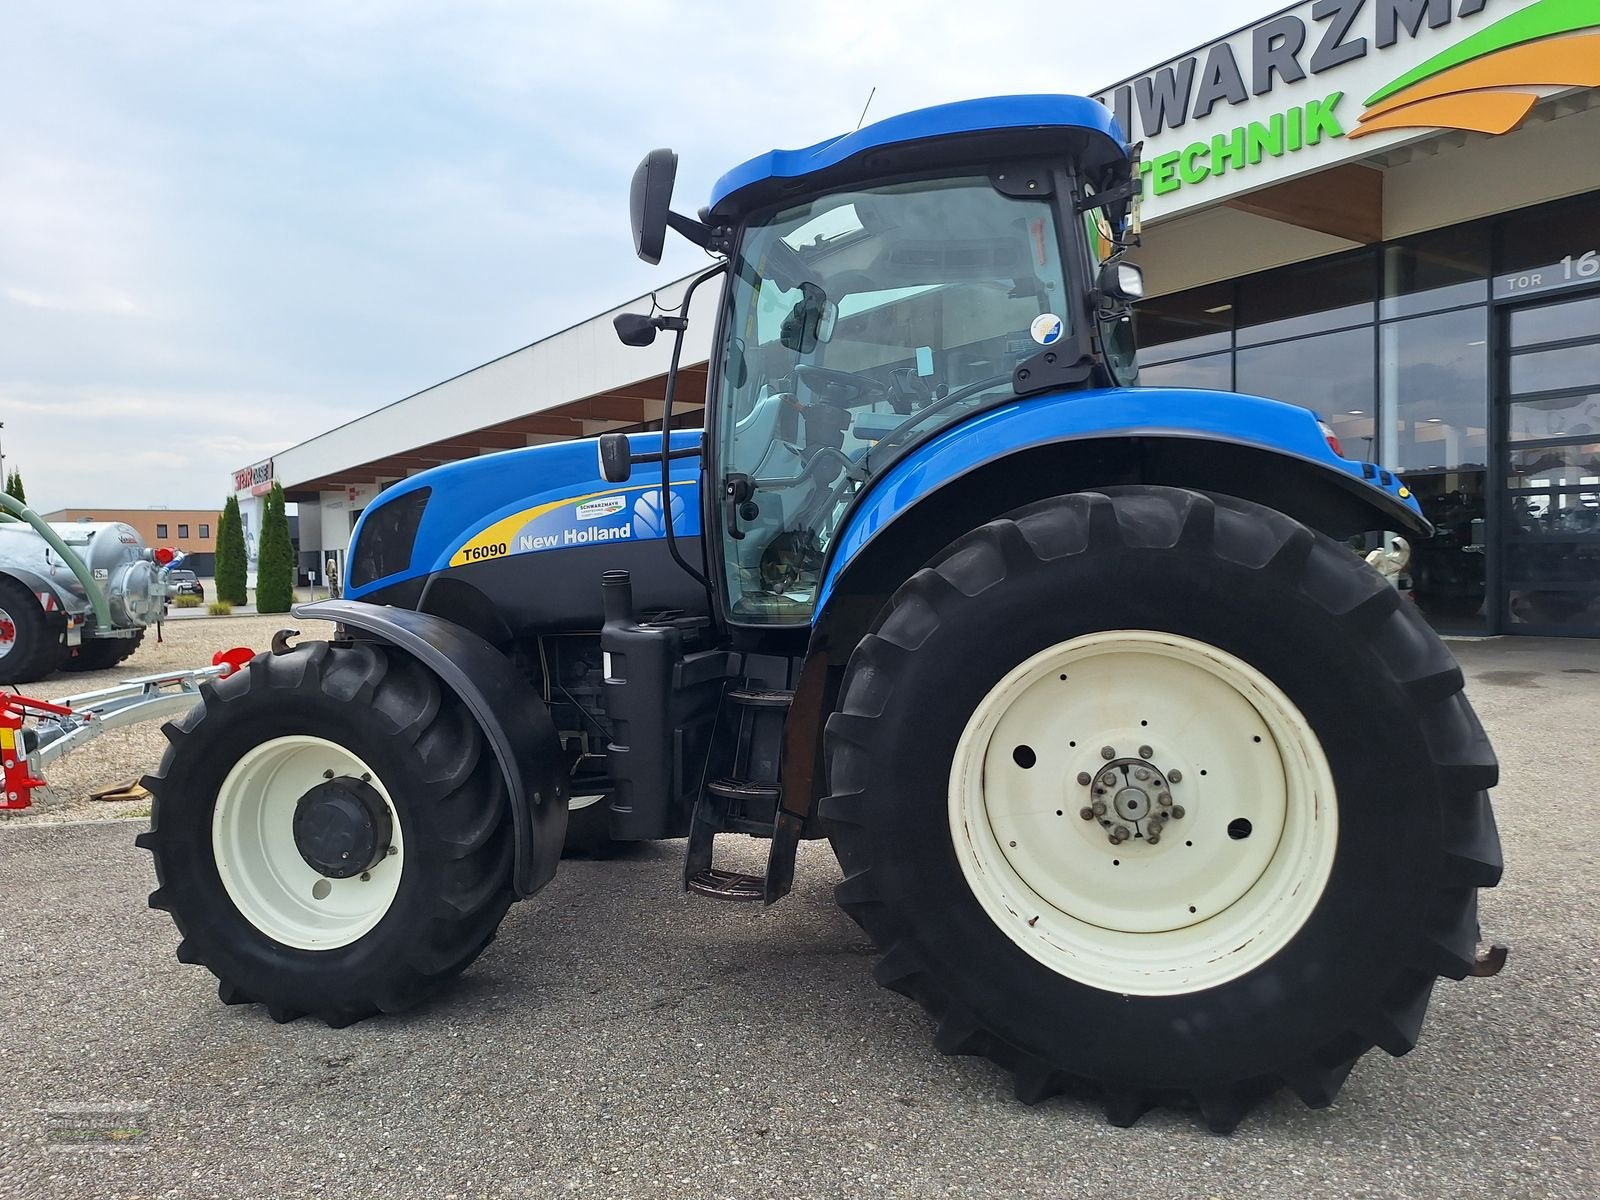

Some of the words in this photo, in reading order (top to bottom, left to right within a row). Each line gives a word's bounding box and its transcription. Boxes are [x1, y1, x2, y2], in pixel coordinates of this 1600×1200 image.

[1098, 0, 1488, 143] WARZM
[1507, 273, 1542, 290] TOR
[1560, 249, 1600, 280] 16
[463, 542, 507, 561] T6090
[520, 534, 559, 551] New
[565, 523, 631, 544] Holland
